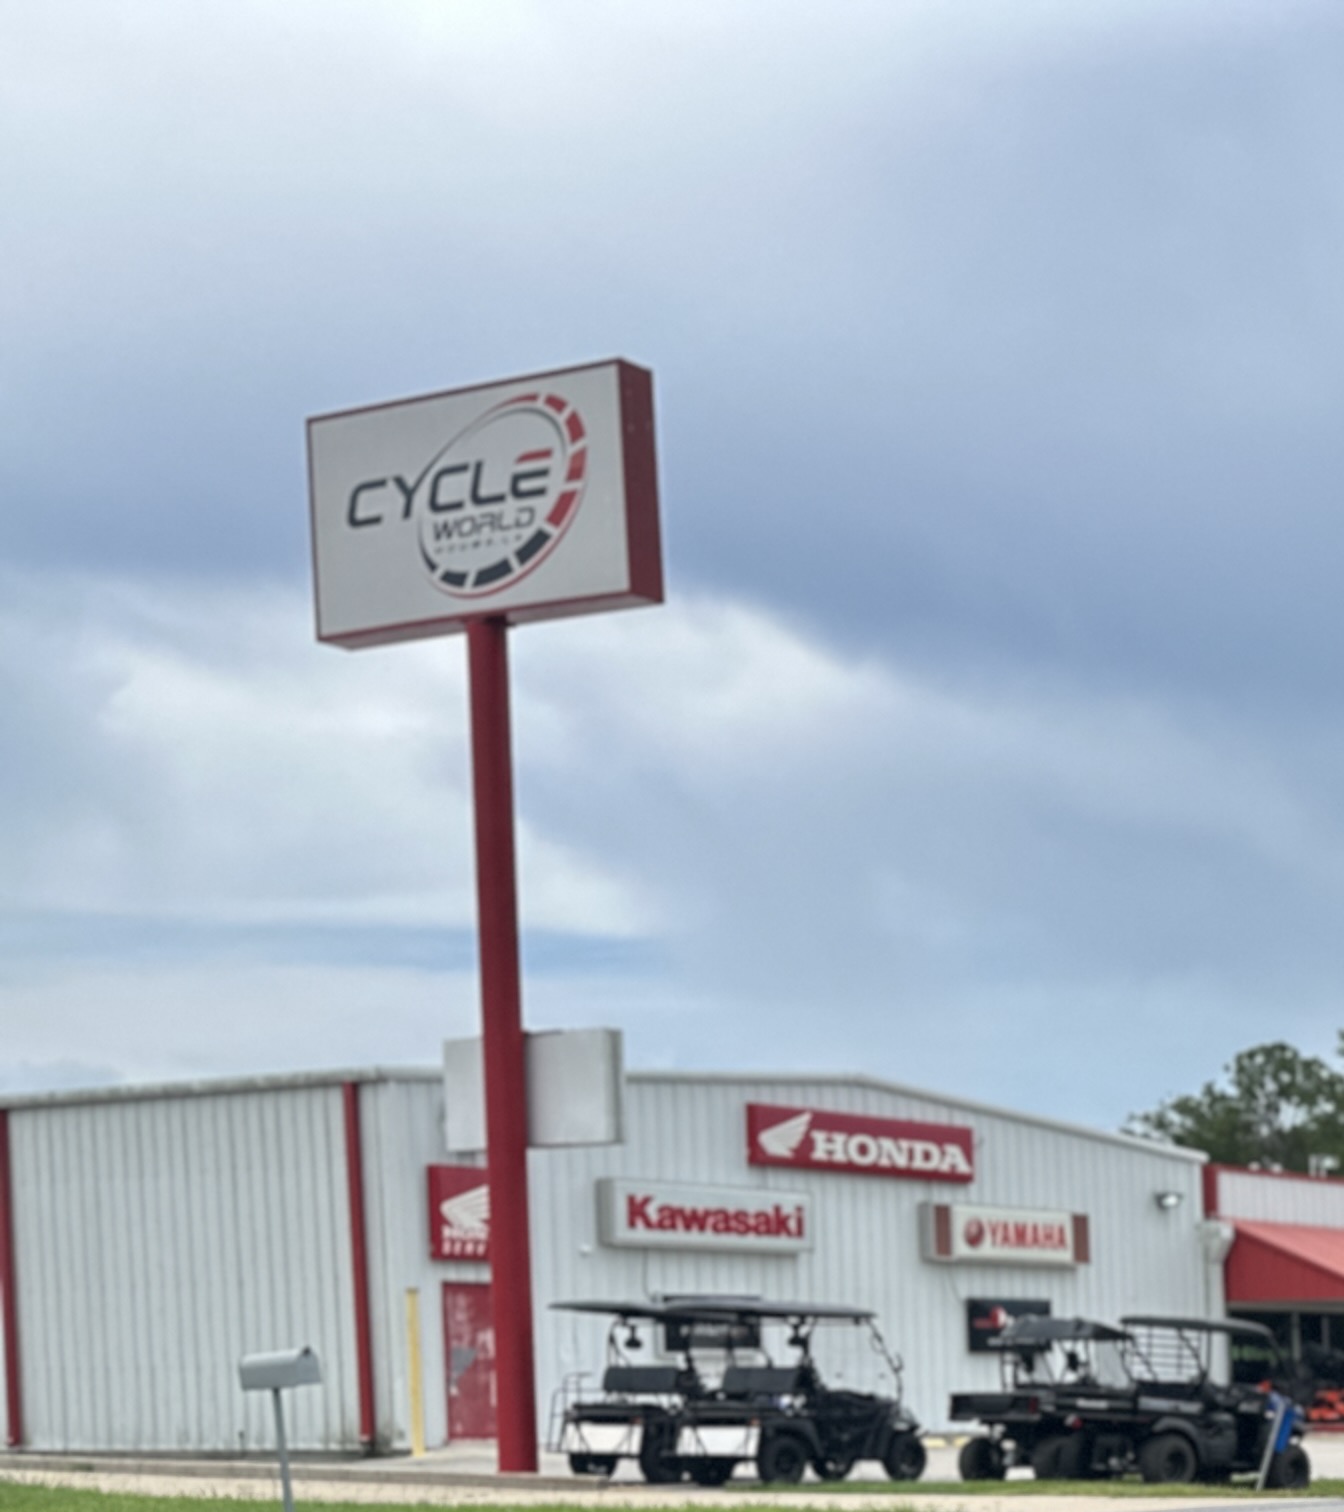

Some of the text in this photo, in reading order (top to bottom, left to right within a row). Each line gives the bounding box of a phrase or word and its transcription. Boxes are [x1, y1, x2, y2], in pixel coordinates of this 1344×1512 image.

[348, 449, 552, 528] CYCLE
[432, 506, 537, 542] WORLD
[810, 1129, 974, 1175] HONDA
[626, 1194, 804, 1238] Kawasaki
[988, 1219, 1068, 1249] YAMAHA
